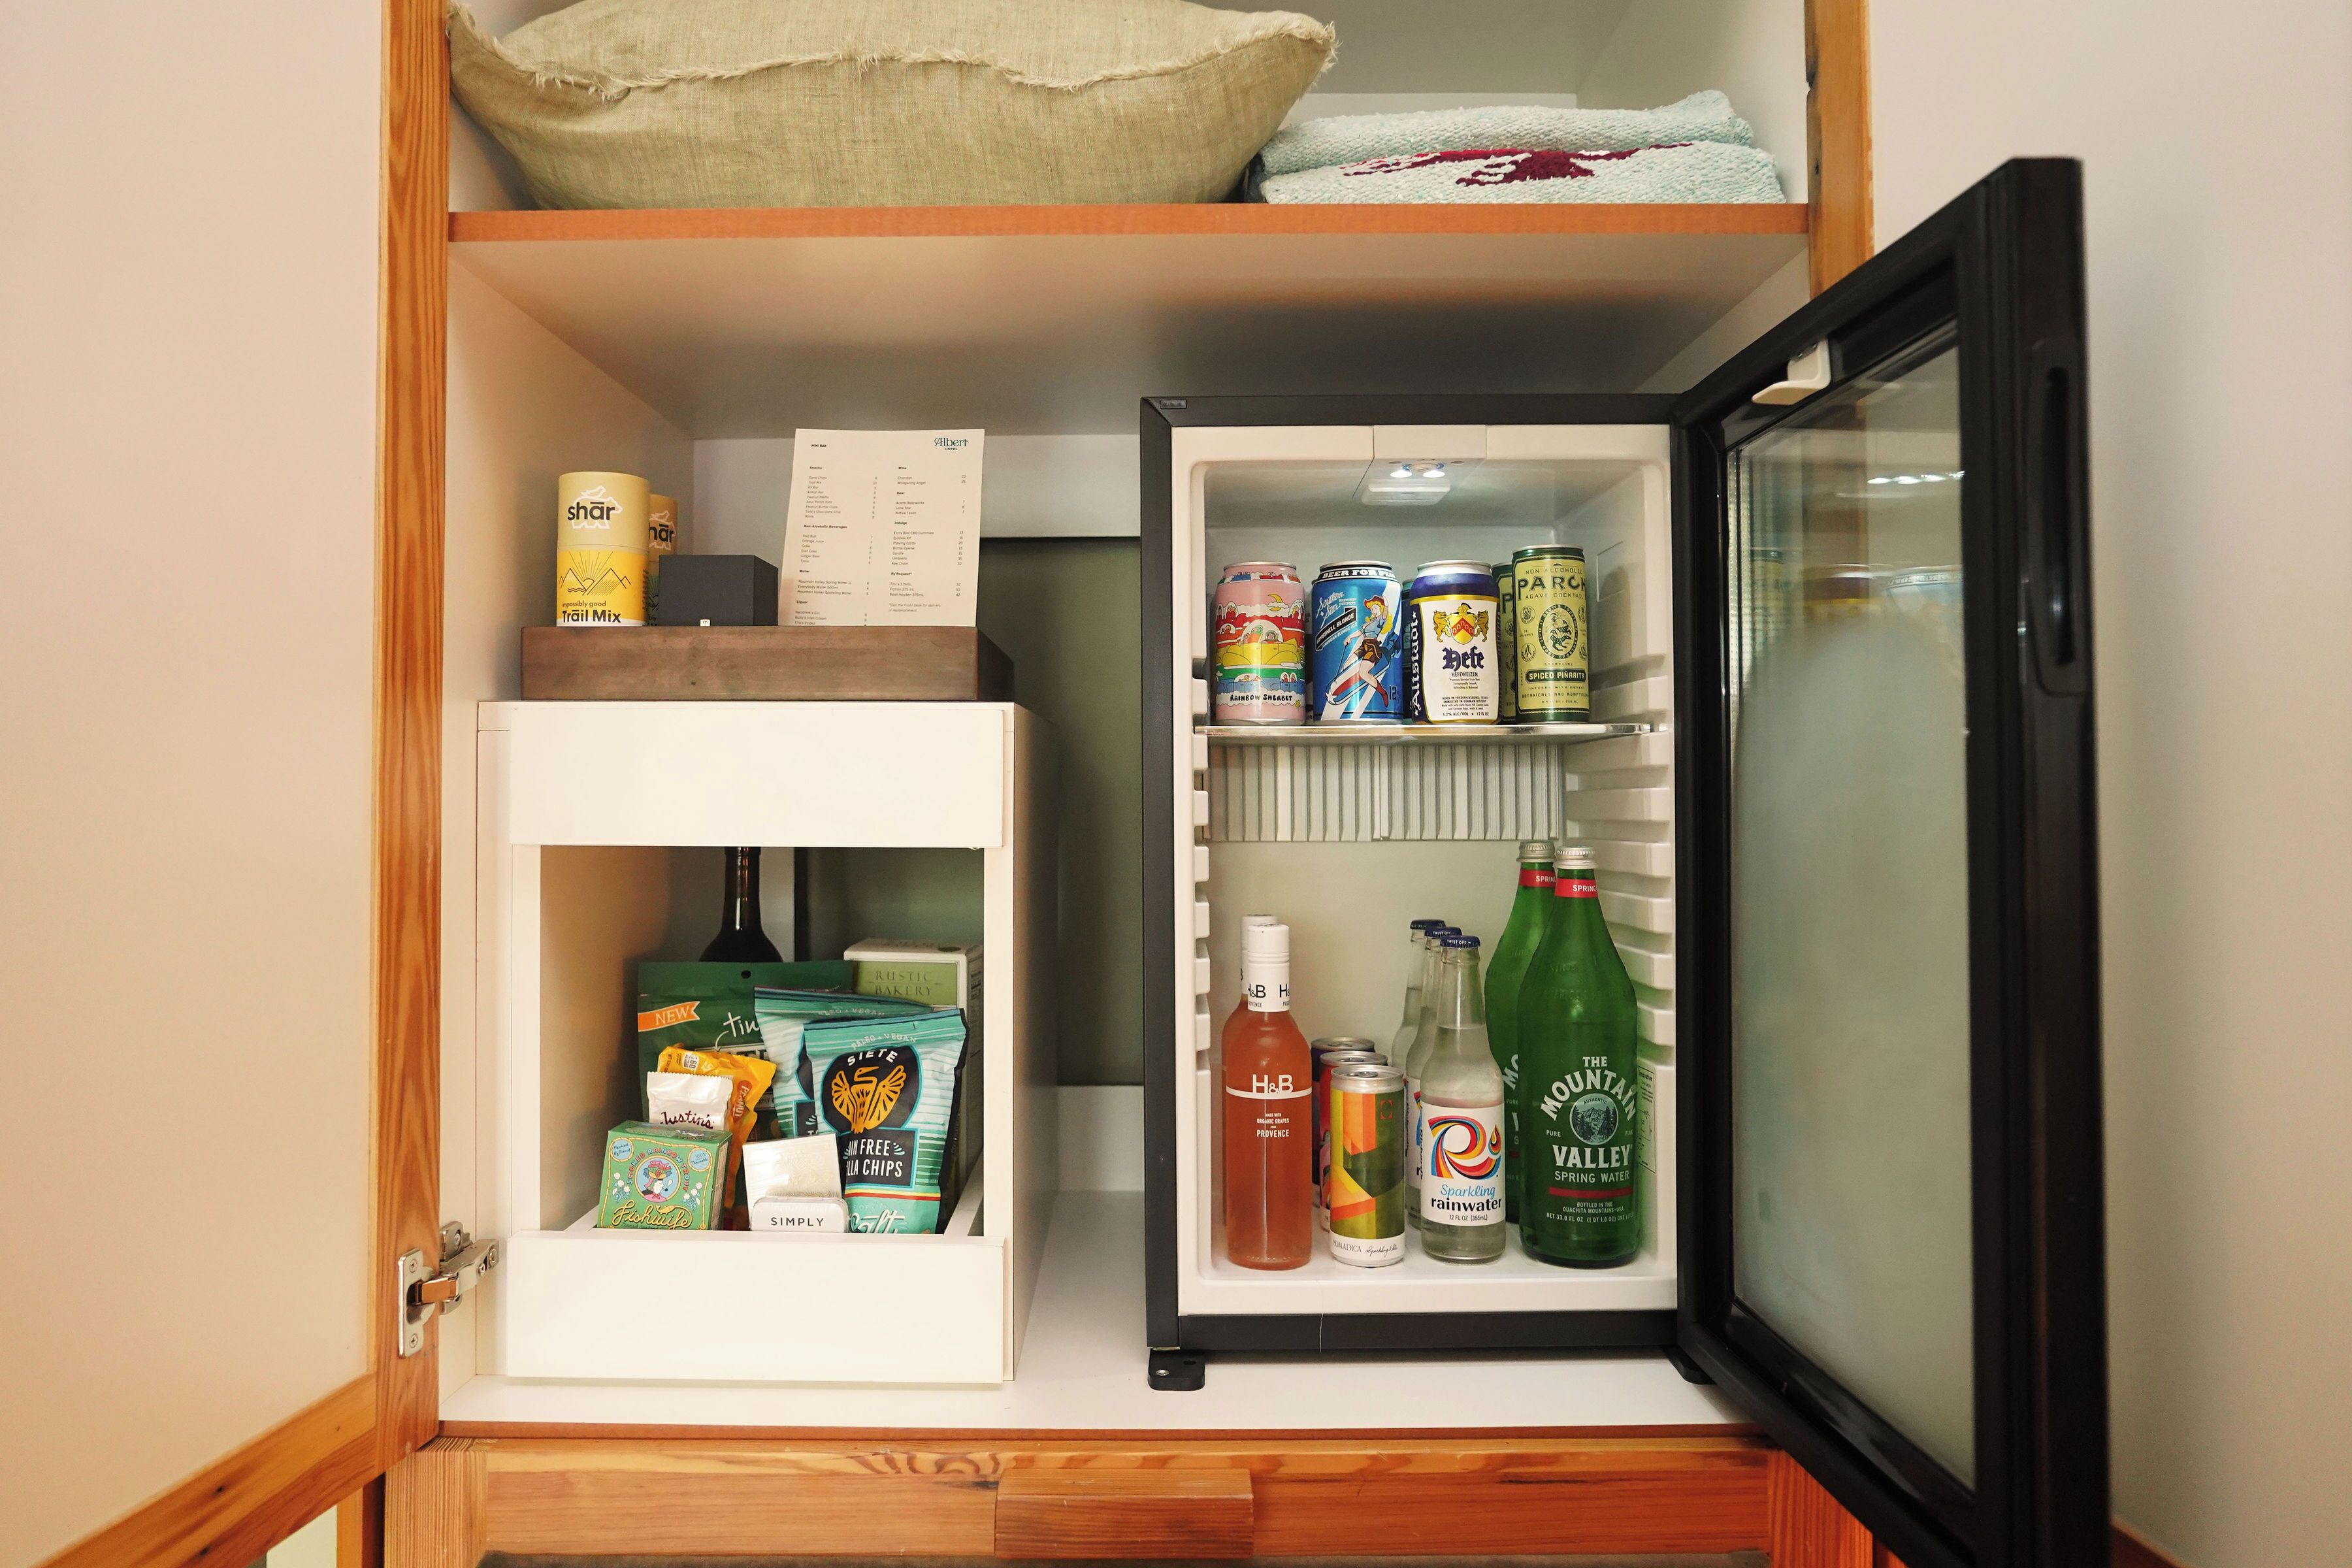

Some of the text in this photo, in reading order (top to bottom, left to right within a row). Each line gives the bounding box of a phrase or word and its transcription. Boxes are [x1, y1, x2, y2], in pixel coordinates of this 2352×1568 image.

[934, 438, 968, 447] Albert
[567, 502, 615, 521] shār
[649, 524, 674, 543] hār
[1322, 570, 1349, 579] BEER
[1518, 575, 1586, 601] PARCH
[593, 610, 621, 623] Mix
[1336, 613, 1354, 627] BLONDE
[1442, 645, 1484, 672] Hefe
[1389, 686, 1397, 700] 12
[875, 971, 932, 981] RUSTIC
[875, 985, 932, 996] BAKERY
[655, 1005, 690, 1025] NEW
[723, 1012, 762, 1038] tin
[851, 1033, 917, 1050] PALEO VEGAN
[847, 1048, 899, 1066] SIETE
[1582, 1056, 1608, 1068] THE
[1252, 1074, 1294, 1094] H&B
[732, 1085, 749, 1118] PEANUT
[1541, 1069, 1637, 1122] MOUNTAIN
[661, 1110, 713, 1130] Justin's
[1256, 1129, 1290, 1137] PROVENCE
[860, 1139, 891, 1156] FREE
[1552, 1145, 1631, 1169] VALLEY
[627, 1147, 690, 1192] SMOKED RAINBOW TROUT
[862, 1159, 903, 1177] CHIPS
[1554, 1171, 1629, 1183] SPRING WATER
[1440, 1184, 1495, 1200] Sparkling
[1431, 1197, 1502, 1212] rainwater
[612, 1200, 693, 1230] Fishwife
[771, 1217, 824, 1226] SIMPLY
[849, 1209, 906, 1234] Salt
[1333, 1239, 1362, 1252] NOMADICA
